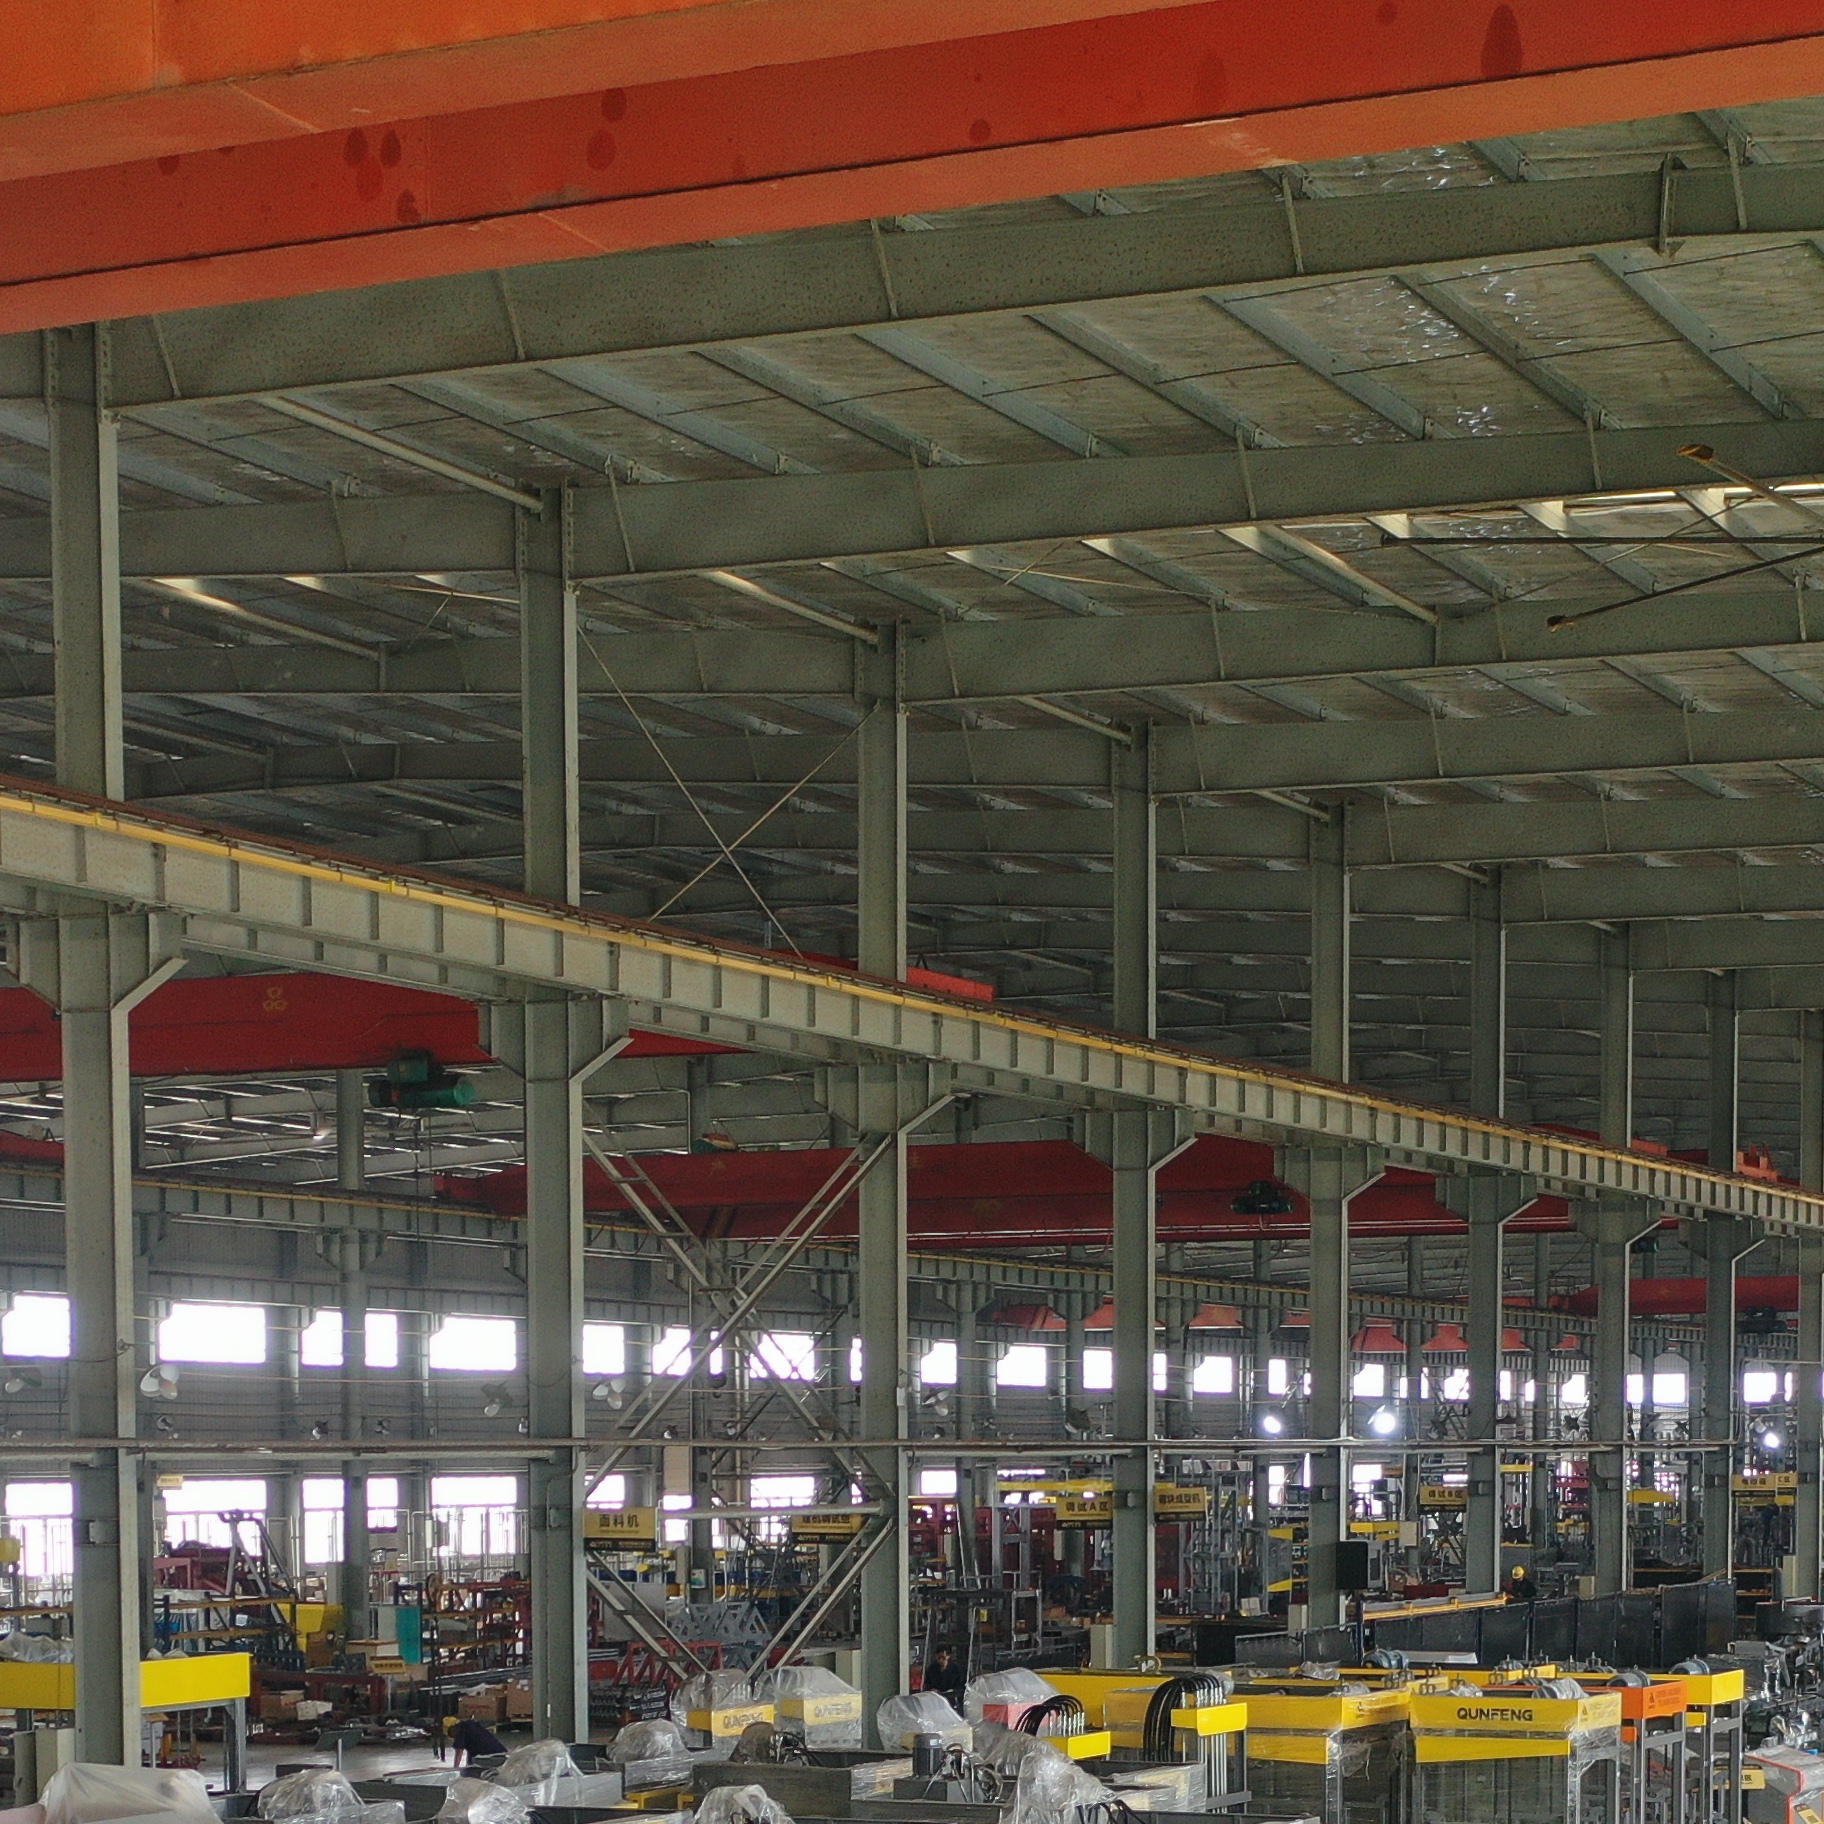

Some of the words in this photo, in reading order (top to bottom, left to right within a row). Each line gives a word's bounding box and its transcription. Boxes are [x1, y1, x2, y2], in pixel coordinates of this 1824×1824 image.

[599, 1513, 639, 1528] 面料机
[1457, 1707, 1533, 1721] QUNFENG
